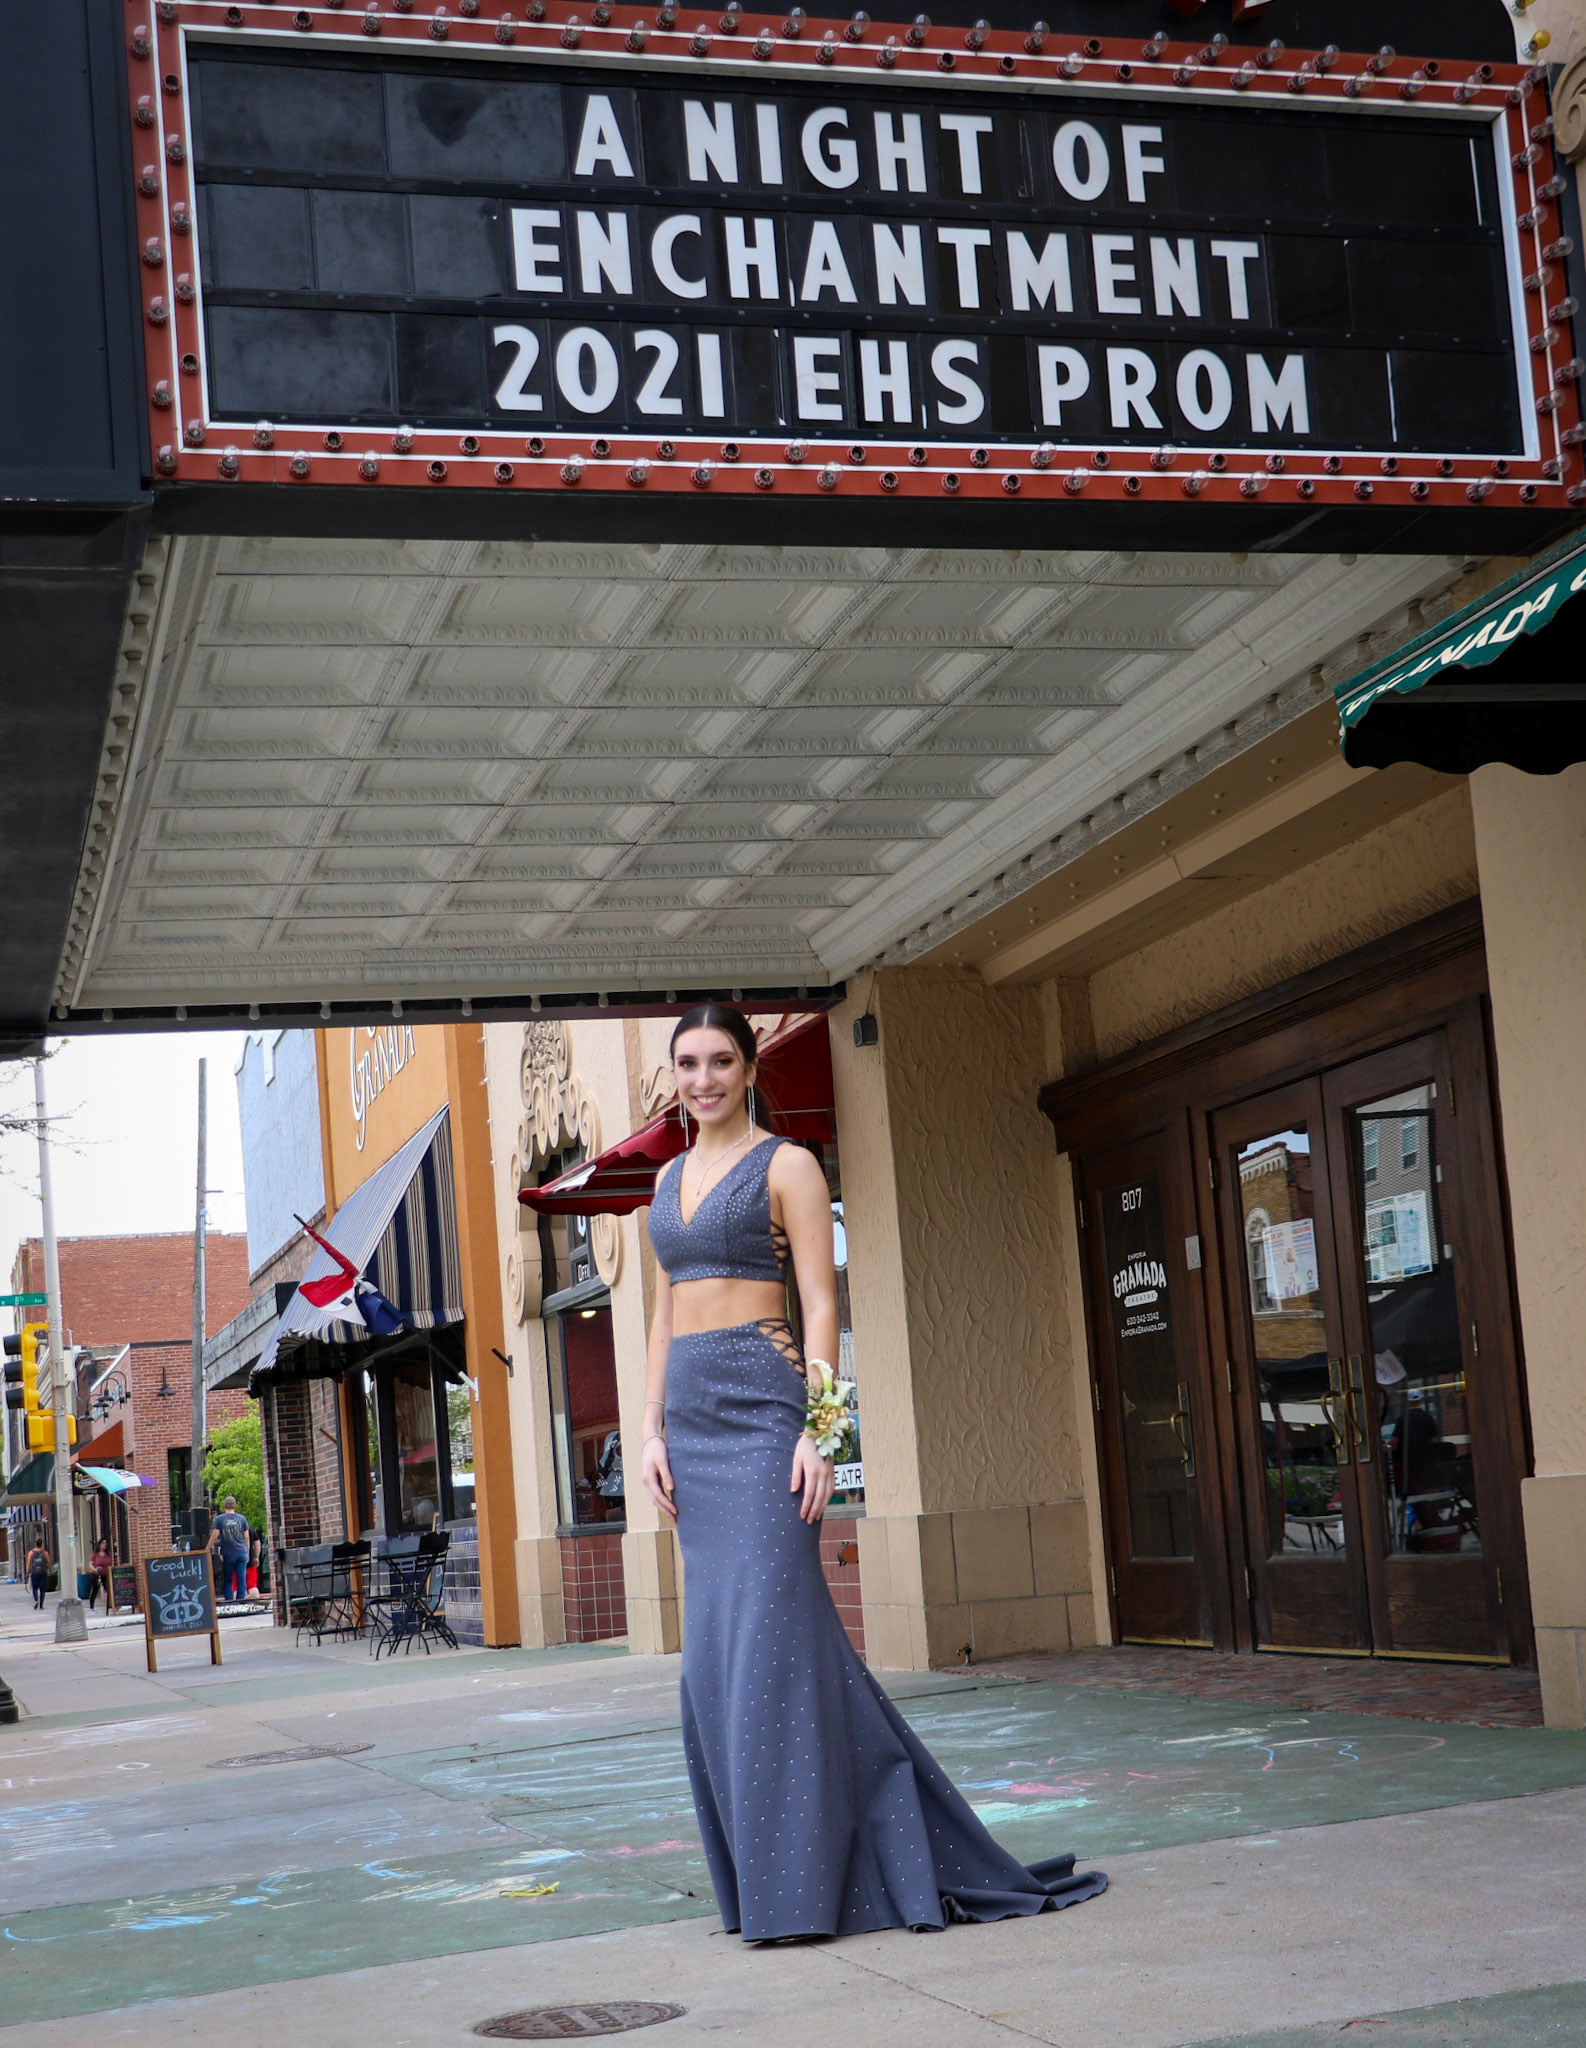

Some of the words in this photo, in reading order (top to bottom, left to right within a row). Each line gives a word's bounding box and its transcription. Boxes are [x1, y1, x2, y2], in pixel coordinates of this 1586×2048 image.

[574, 95, 635, 178] A
[683, 99, 993, 194] NIGHT
[1052, 119, 1166, 203] OF
[510, 207, 1260, 320] ENCHANTMENT
[493, 324, 726, 418] 2021
[793, 336, 986, 425] EHS
[1037, 344, 1311, 435] PROM
[1121, 1187, 1143, 1212] 807
[1127, 1251, 1147, 1261] EMPORIA
[1112, 1261, 1168, 1298] GRANADA
[1127, 1292, 1155, 1304] THEATRE
[151, 1556, 185, 1572] Good
